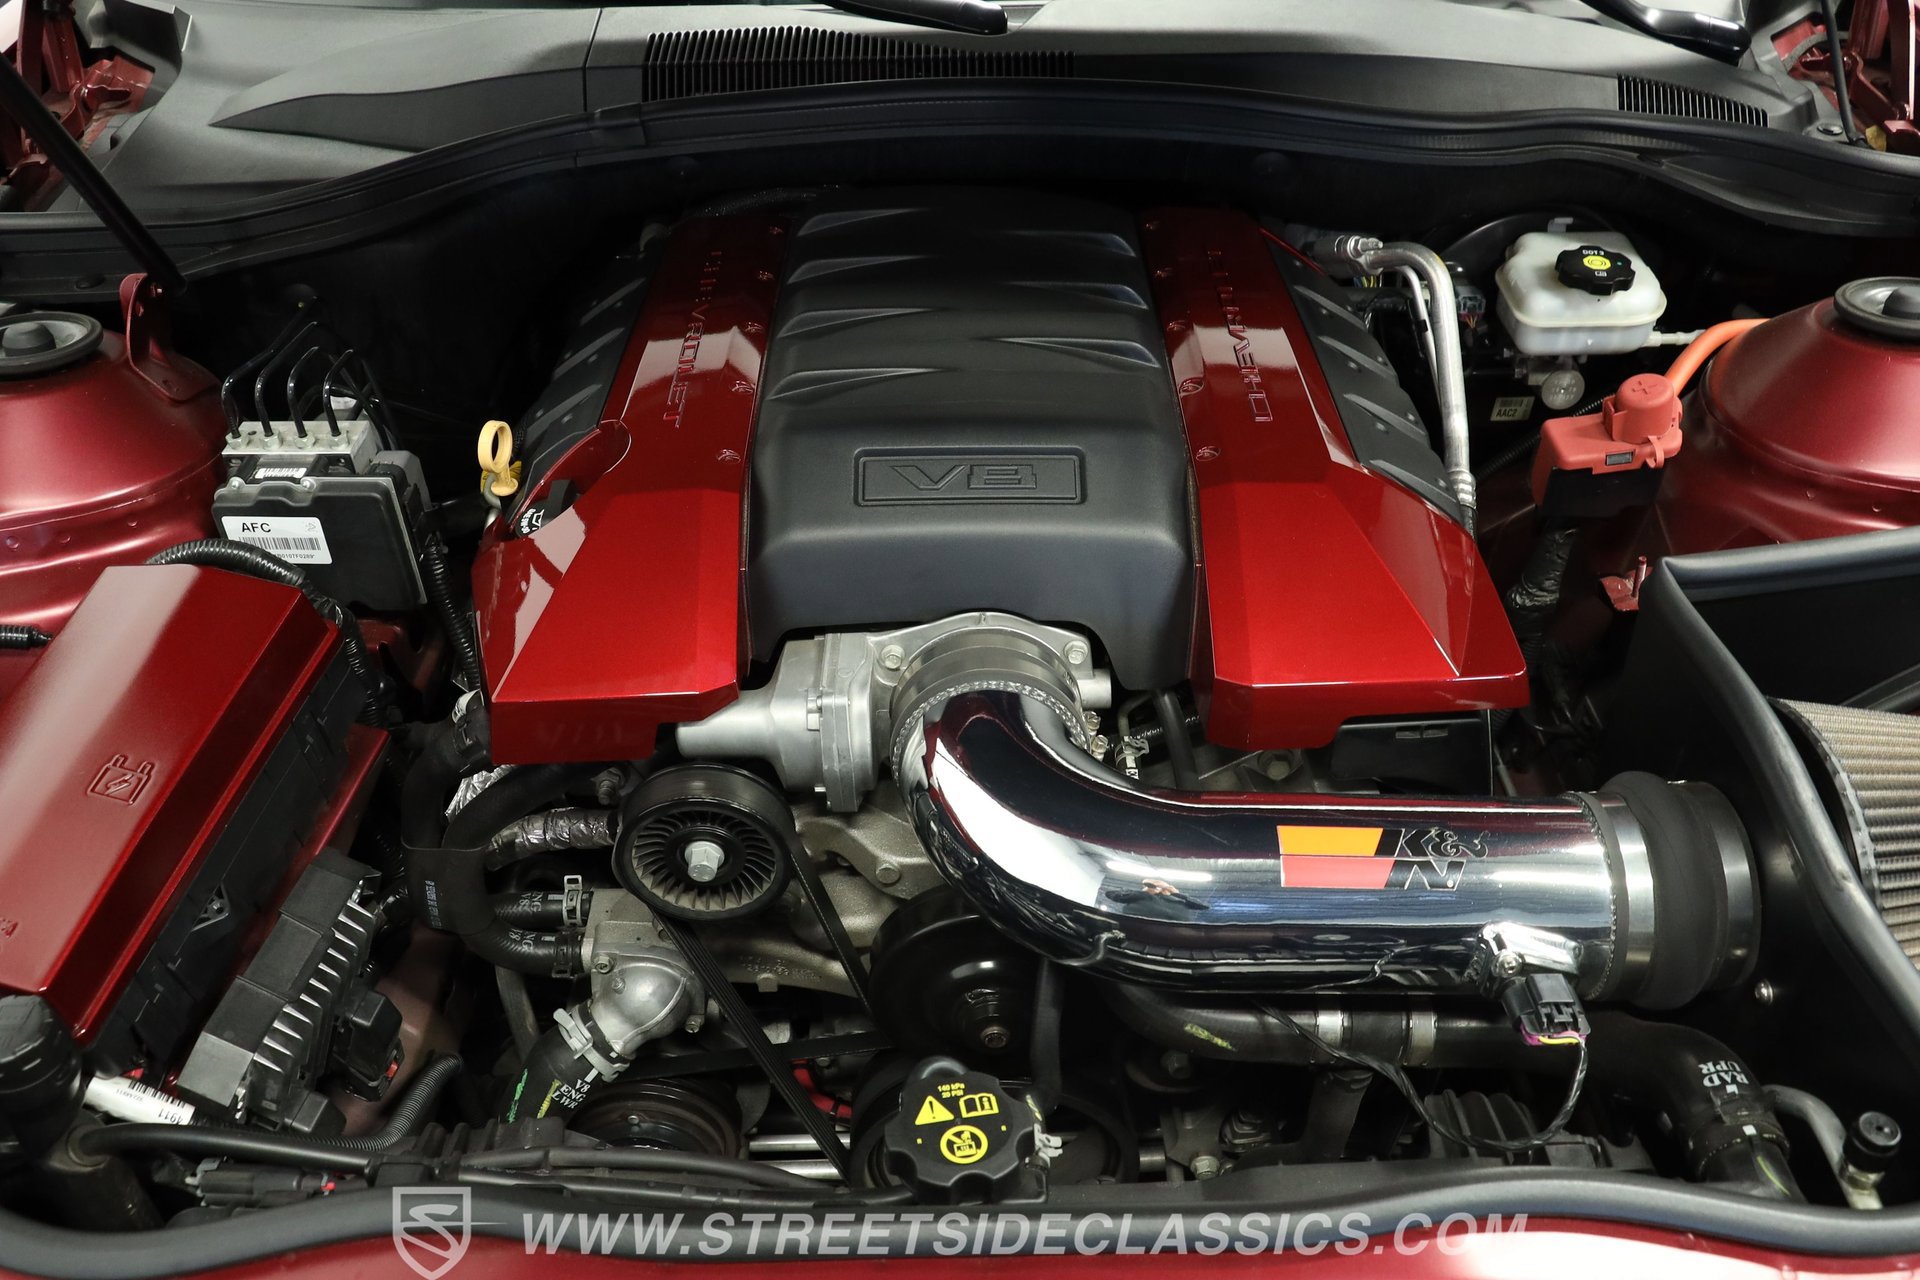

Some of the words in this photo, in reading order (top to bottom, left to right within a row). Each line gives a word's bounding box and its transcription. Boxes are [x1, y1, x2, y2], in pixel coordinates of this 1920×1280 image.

[1582, 248, 1598, 256] DOT
[1207, 250, 1274, 422] CHEVRO
[1496, 407, 1519, 418] AAC2
[888, 464, 1038, 491] V8
[241, 522, 272, 534] AFC
[1393, 826, 1489, 892] K&N
[1698, 1060, 1742, 1074] UPR
[575, 1079, 591, 1093] V8
[937, 1084, 951, 1092] 140
[951, 1082, 965, 1090] kPa
[1702, 1071, 1749, 1088] RAD
[551, 1090, 579, 1109] LWR
[560, 1083, 586, 1102] ENG
[951, 1089, 964, 1097] PSI
[158, 1108, 183, 1124] 4911
